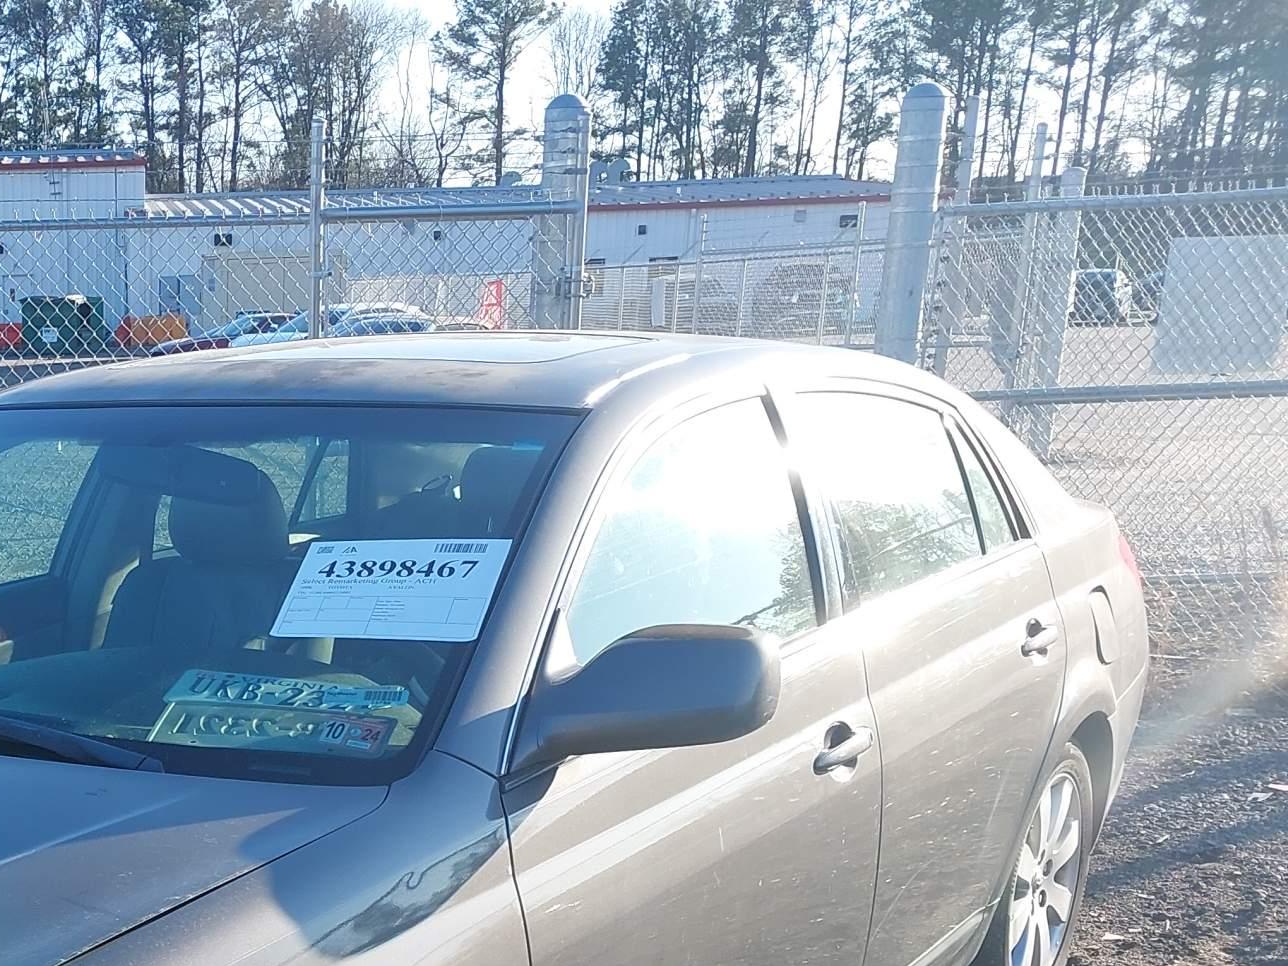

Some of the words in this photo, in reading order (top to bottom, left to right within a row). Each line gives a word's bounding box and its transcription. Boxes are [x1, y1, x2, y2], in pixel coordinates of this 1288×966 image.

[318, 559, 480, 579] 43898467
[325, 720, 346, 740] 10
[360, 728, 382, 741] 24
